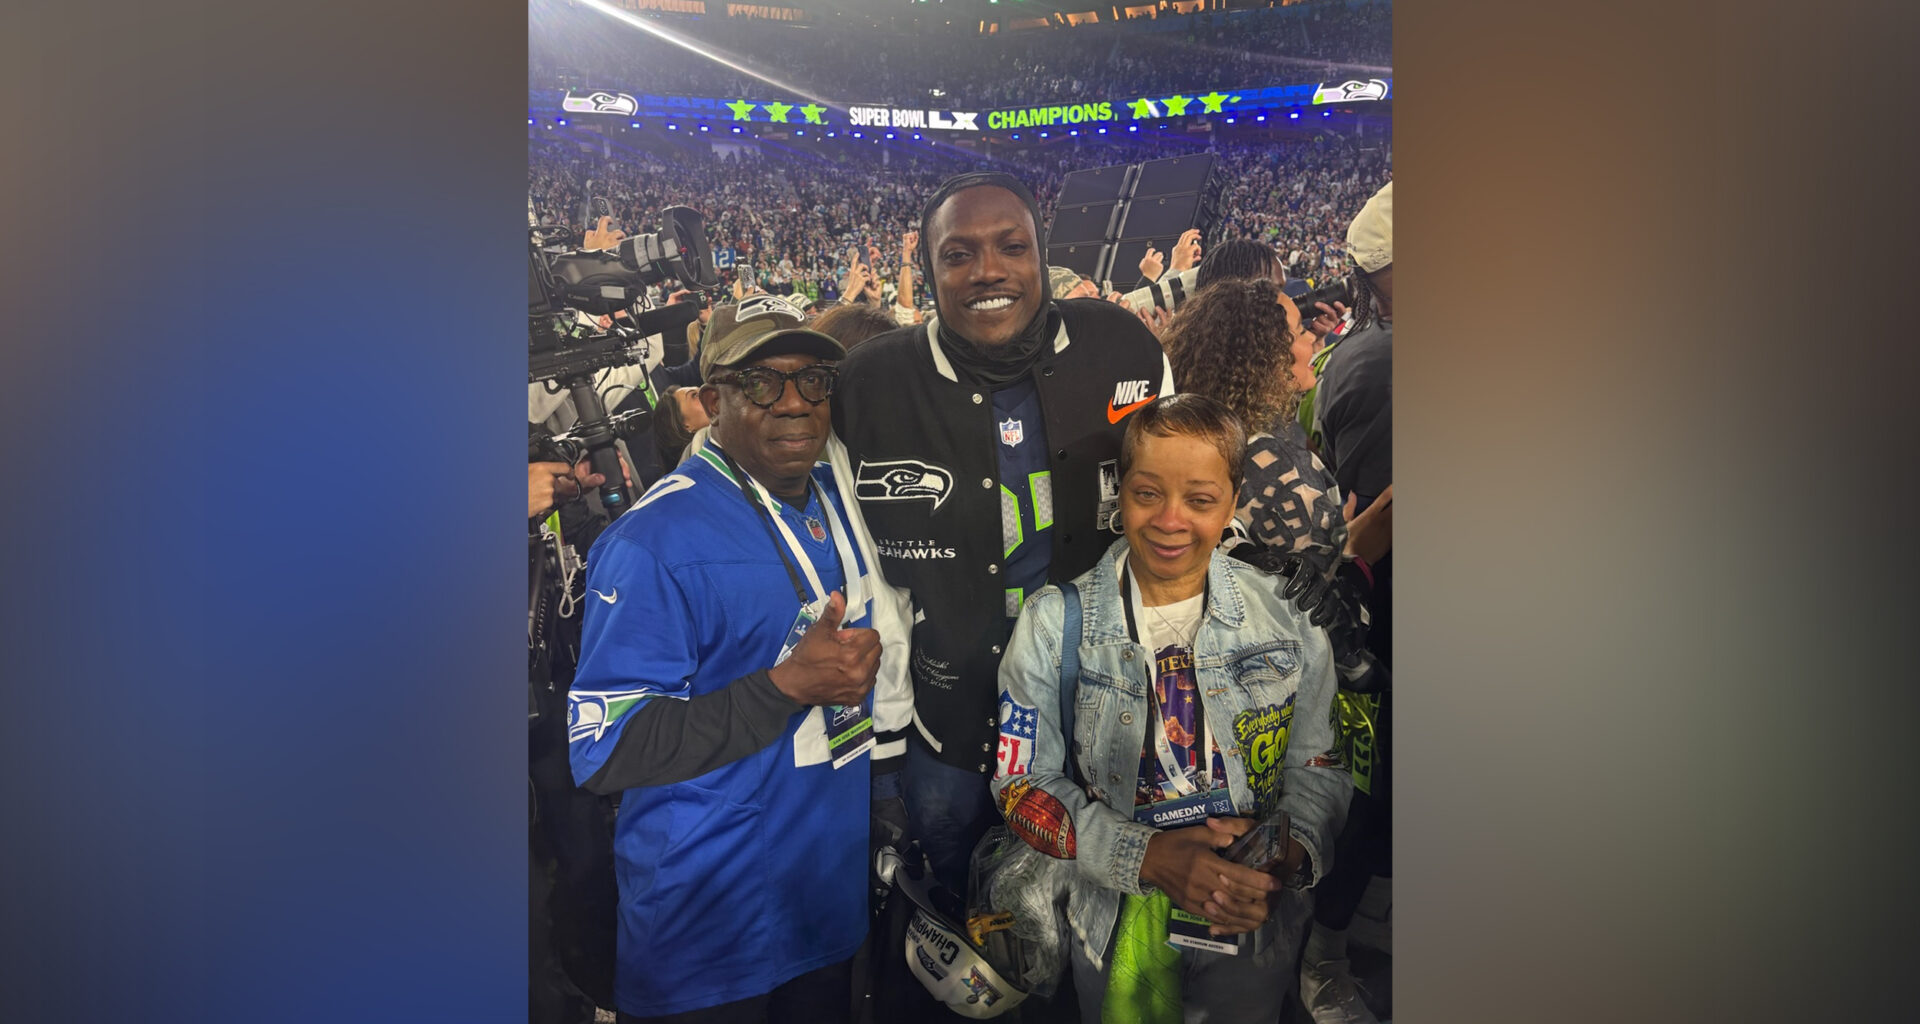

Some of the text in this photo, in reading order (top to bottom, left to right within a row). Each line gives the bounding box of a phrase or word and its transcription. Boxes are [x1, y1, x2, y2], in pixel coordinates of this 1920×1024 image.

[849, 102, 1113, 131] SUPER BOWL LX CHAMPIONS
[1112, 380, 1150, 406] NIKE
[877, 546, 957, 560] EAHAWKS
[1236, 705, 1280, 741] Everybody
[1153, 803, 1206, 823] GAMEDAY
